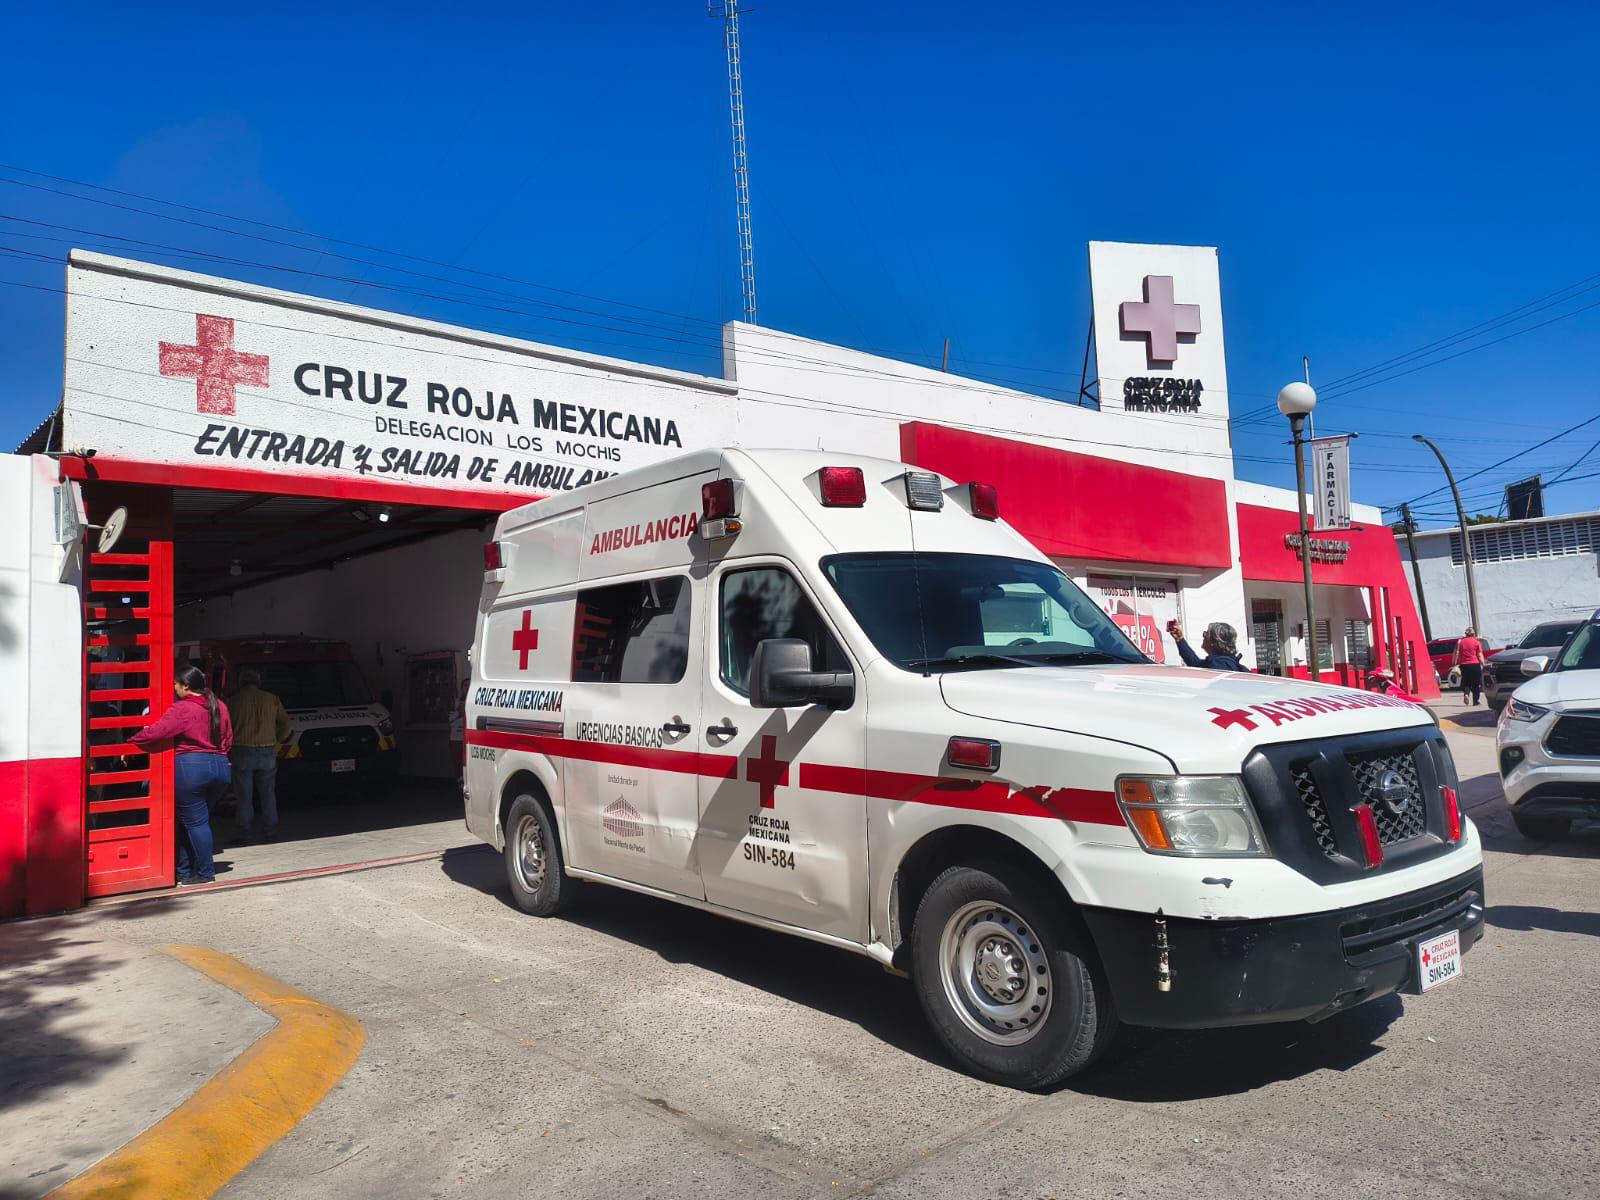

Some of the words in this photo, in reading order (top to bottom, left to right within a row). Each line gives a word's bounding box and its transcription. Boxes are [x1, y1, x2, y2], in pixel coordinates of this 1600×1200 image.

[294, 362, 408, 409] CRUZ
[427, 382, 519, 425] ROJA
[533, 398, 682, 448] MEXICANA
[375, 416, 493, 446] DELEGACION
[507, 433, 543, 452] LOS
[556, 440, 621, 461] MOCHIS
[194, 423, 345, 468] ENTRADA
[377, 447, 459, 479] SALIDA
[466, 456, 498, 483] DE
[504, 460, 619, 491] AMBULA
[1326, 452, 1336, 527] FARMACIA
[590, 511, 698, 555] AMBULANCIA
[1100, 586, 1118, 596] TODOS
[1119, 587, 1130, 597] LOS
[474, 686, 496, 706] CRUZ
[495, 688, 517, 709] ROJA
[517, 689, 563, 712] MEXICANA
[576, 721, 623, 744] URGENCIAS
[624, 725, 663, 749] BASICAS
[471, 746, 480, 759] LOS
[480, 747, 496, 762] MOCHIS
[748, 815, 768, 827] CRUZ
[770, 818, 790, 831] ROJA
[749, 827, 790, 844] MEXICANA
[744, 842, 795, 870] SIN-584
[1431, 942, 1444, 953] CRUZ
[1444, 935, 1457, 948] ROJA
[1432, 948, 1458, 964] MEXICANA
[1429, 960, 1455, 983] SIN-584
